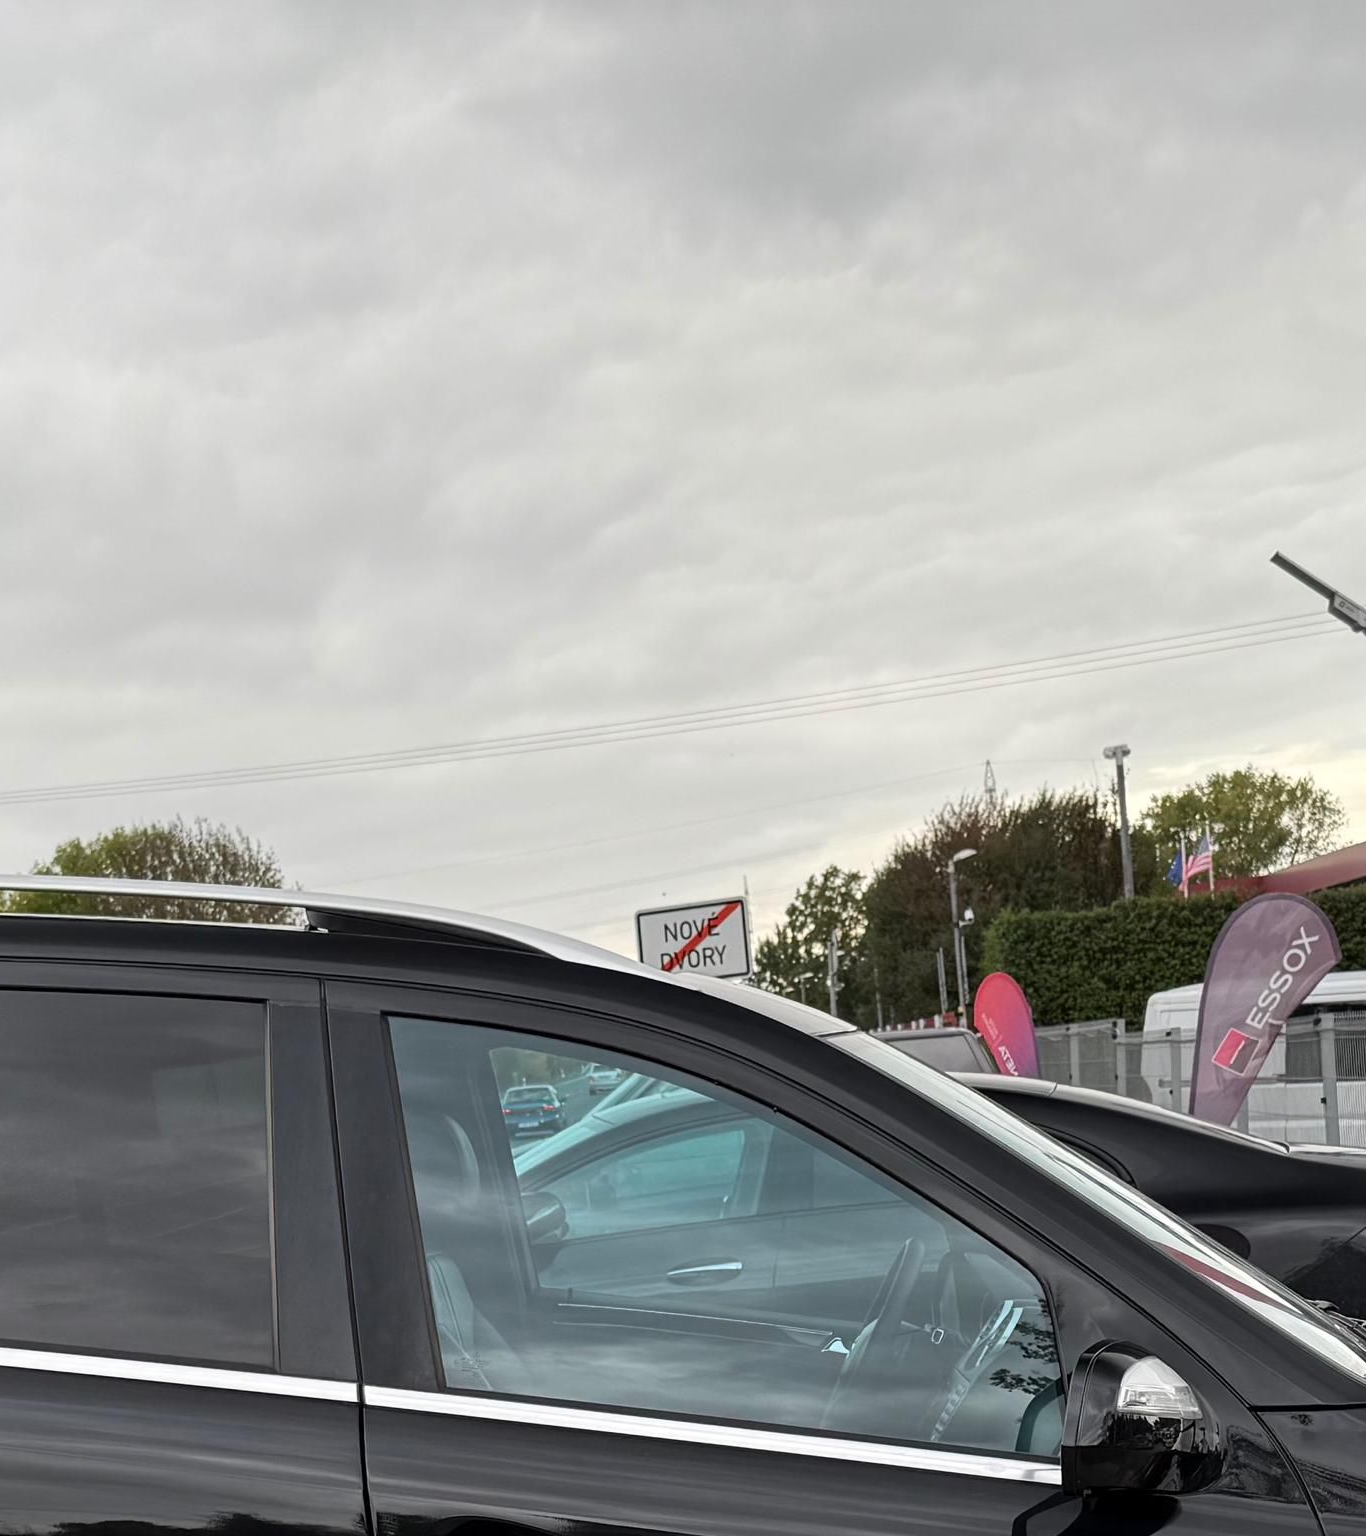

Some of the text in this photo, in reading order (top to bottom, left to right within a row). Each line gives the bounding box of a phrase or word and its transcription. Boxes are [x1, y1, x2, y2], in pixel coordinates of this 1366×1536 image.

[664, 912, 720, 943] NOVÉ
[660, 944, 727, 970] DVORY
[1246, 926, 1320, 1030] ESSOX
